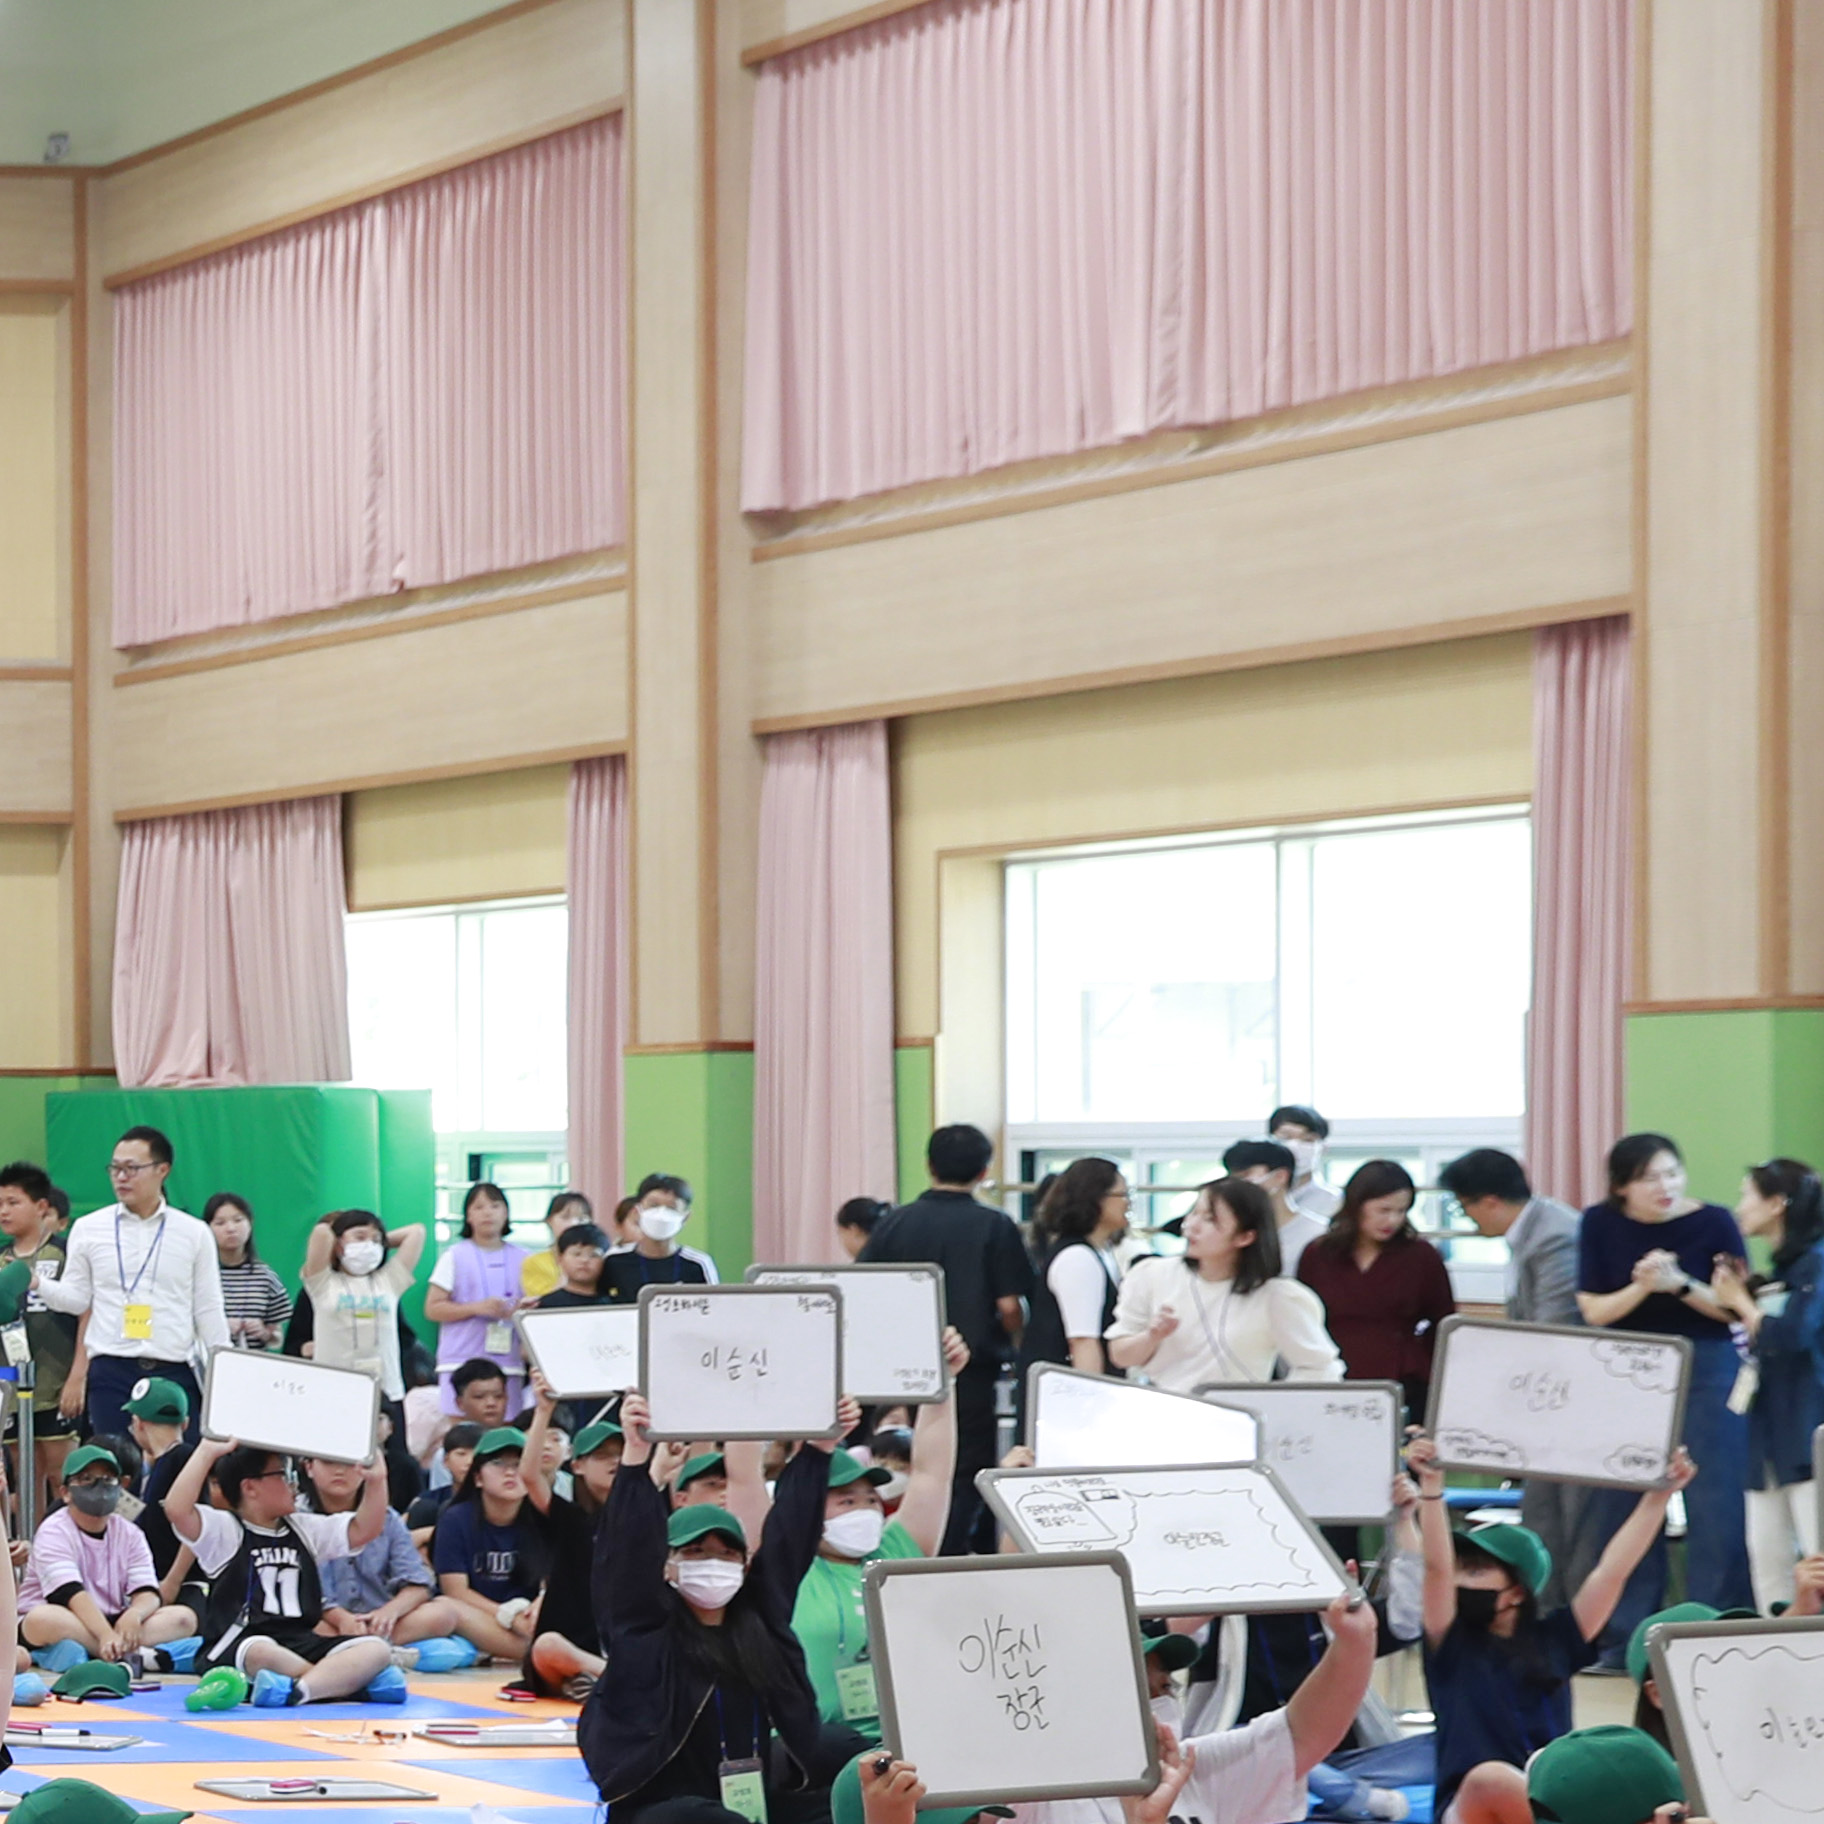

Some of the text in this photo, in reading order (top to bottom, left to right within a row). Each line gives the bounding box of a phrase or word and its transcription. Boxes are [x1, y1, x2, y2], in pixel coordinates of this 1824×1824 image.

[700, 1347, 769, 1381] 이순신
[256, 1566, 303, 1618] 11
[958, 1613, 1048, 1680] 이순신
[996, 1685, 1050, 1731] 장군
